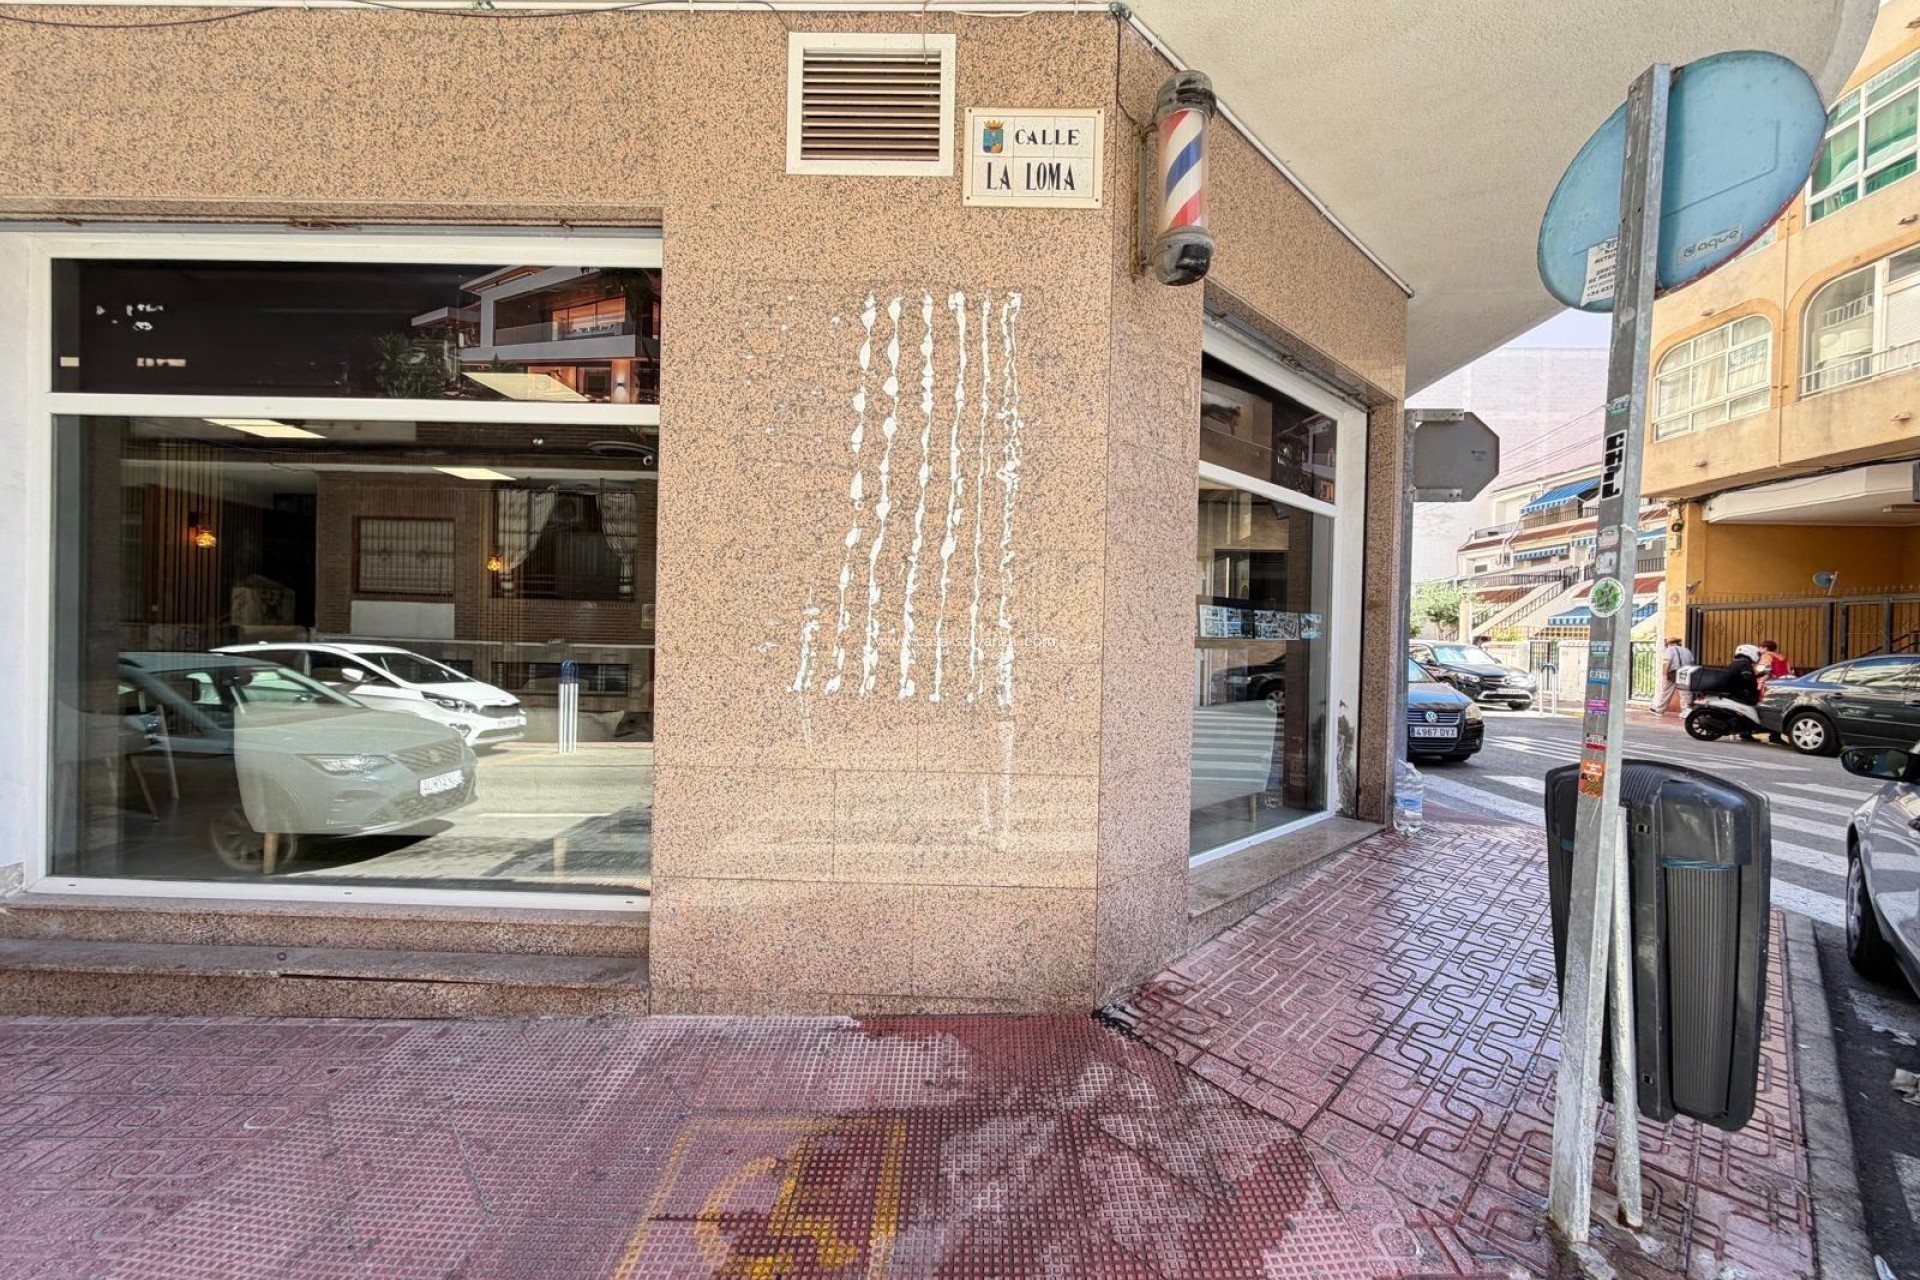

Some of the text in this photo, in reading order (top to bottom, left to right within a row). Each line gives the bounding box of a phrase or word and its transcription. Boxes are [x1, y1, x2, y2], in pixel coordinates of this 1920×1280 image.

[1014, 128, 1081, 146] CALLE
[986, 161, 1076, 191] LA LOMA
